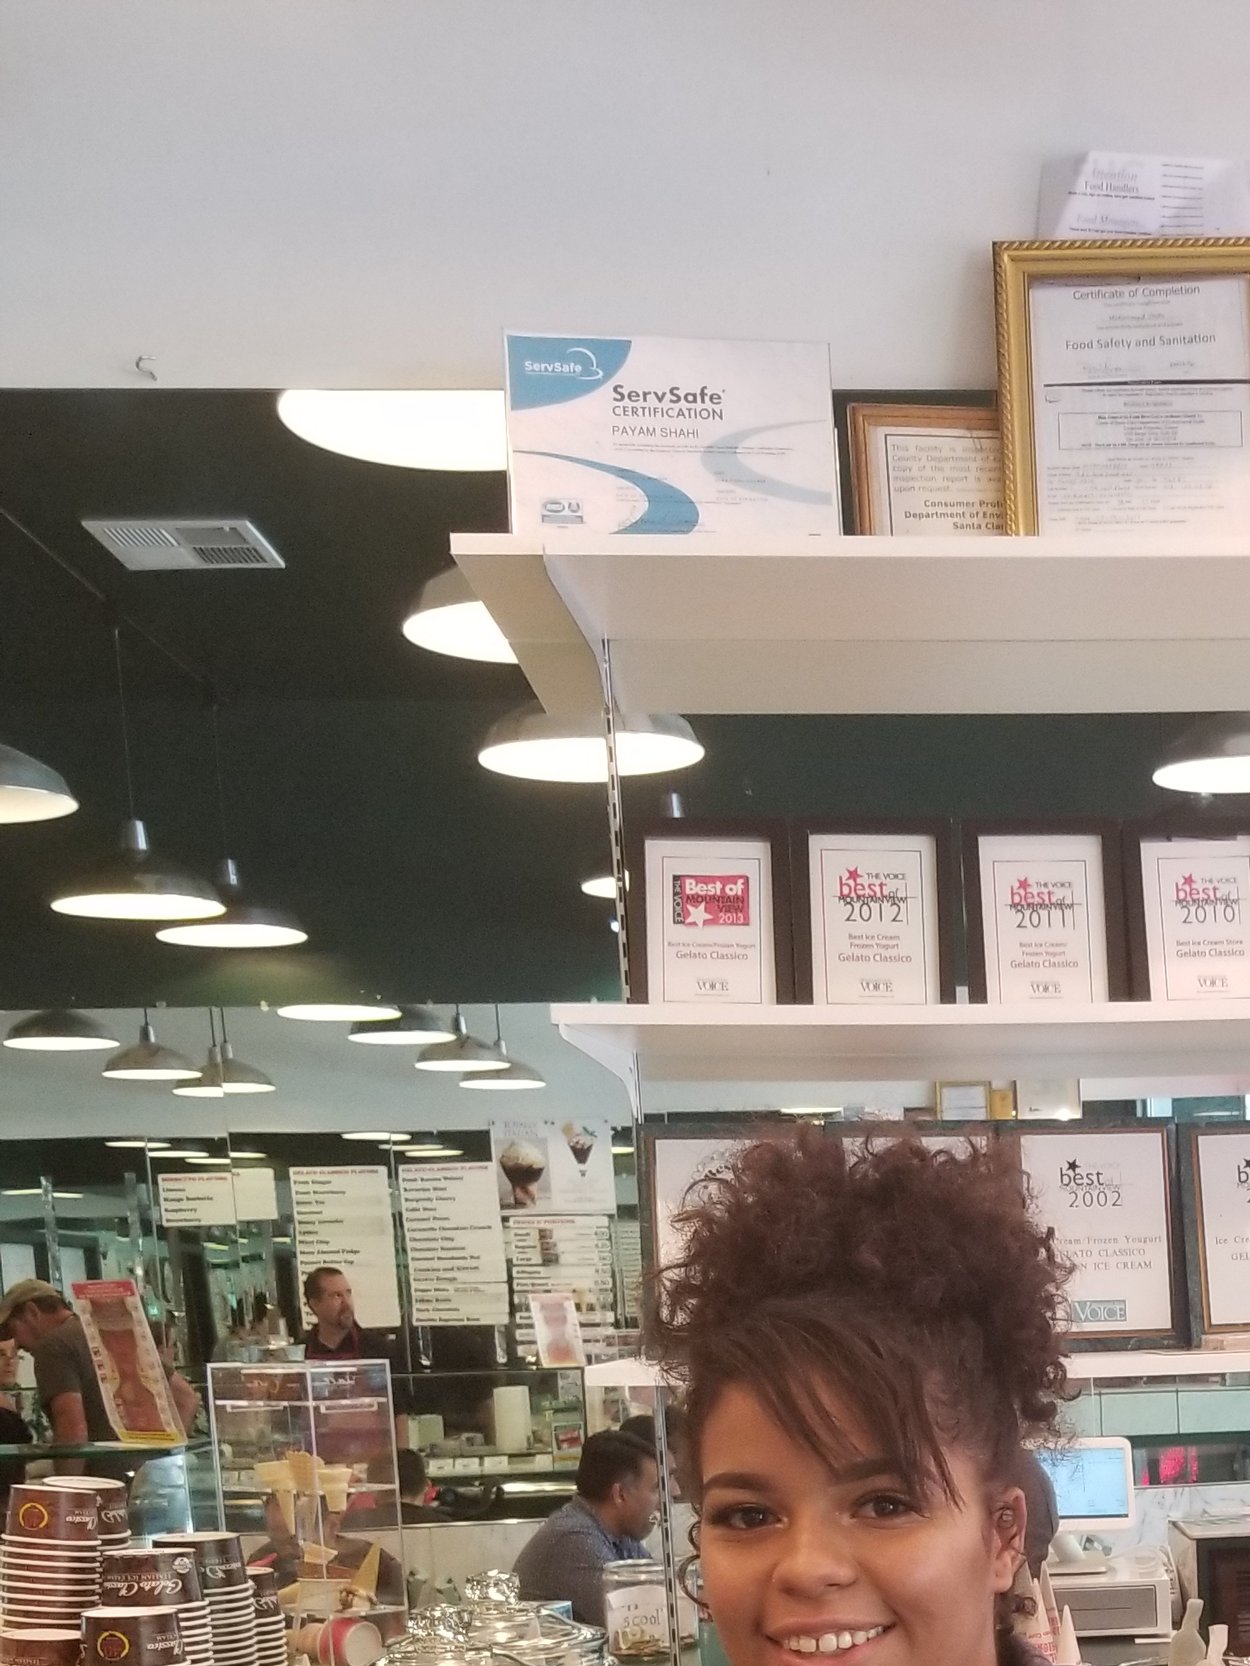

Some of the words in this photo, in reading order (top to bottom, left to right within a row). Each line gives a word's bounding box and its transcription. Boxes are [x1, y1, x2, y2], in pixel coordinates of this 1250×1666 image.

[1073, 289, 1125, 300] Certificate
[1129, 288, 1138, 298] of
[1142, 285, 1200, 298] Completion
[1066, 340, 1094, 350] Food
[1097, 337, 1132, 350] Safety
[1135, 335, 1156, 347] and
[1159, 333, 1216, 345] Sanitation
[525, 361, 582, 373] ServSafe
[612, 384, 723, 405] ServSafe
[612, 405, 724, 421] CERTIFICATION
[612, 425, 657, 438] PAYAM
[660, 427, 699, 439] SHAHI
[924, 500, 975, 508] Consumer
[904, 511, 966, 521] Department
[953, 522, 982, 530] Santa
[685, 879, 722, 895] Best
[725, 879, 744, 895] of
[839, 876, 887, 897] best
[1175, 882, 1219, 901] best
[686, 895, 744, 904] MOUNTAIN
[1011, 886, 1054, 905] best
[717, 904, 743, 912] VIEW
[844, 903, 903, 922] 2012
[1180, 905, 1235, 924] 2010
[719, 913, 743, 923] 2013
[1015, 909, 1065, 928] 2011
[676, 951, 707, 959] Gelato
[710, 952, 748, 960] Classico
[838, 953, 871, 962] Gelato
[873, 953, 912, 963] Classico
[1176, 949, 1207, 958] Gelato
[1208, 948, 1245, 957] Classico
[1010, 960, 1040, 968] Gelato
[1042, 960, 1079, 968] Classico
[697, 981, 728, 991] VOICE
[860, 982, 893, 992] VOICE
[1059, 1167, 1104, 1187] best
[1068, 1190, 1123, 1208] 2002
[1215, 1237, 1228, 1245] Ice
[1098, 1249, 1146, 1257] CLASSICO
[1094, 1262, 1110, 1271] ICE
[1116, 1261, 1152, 1270] CREAM
[1075, 1302, 1126, 1321] VOICE
[141, 1579, 182, 1596] Gelato
